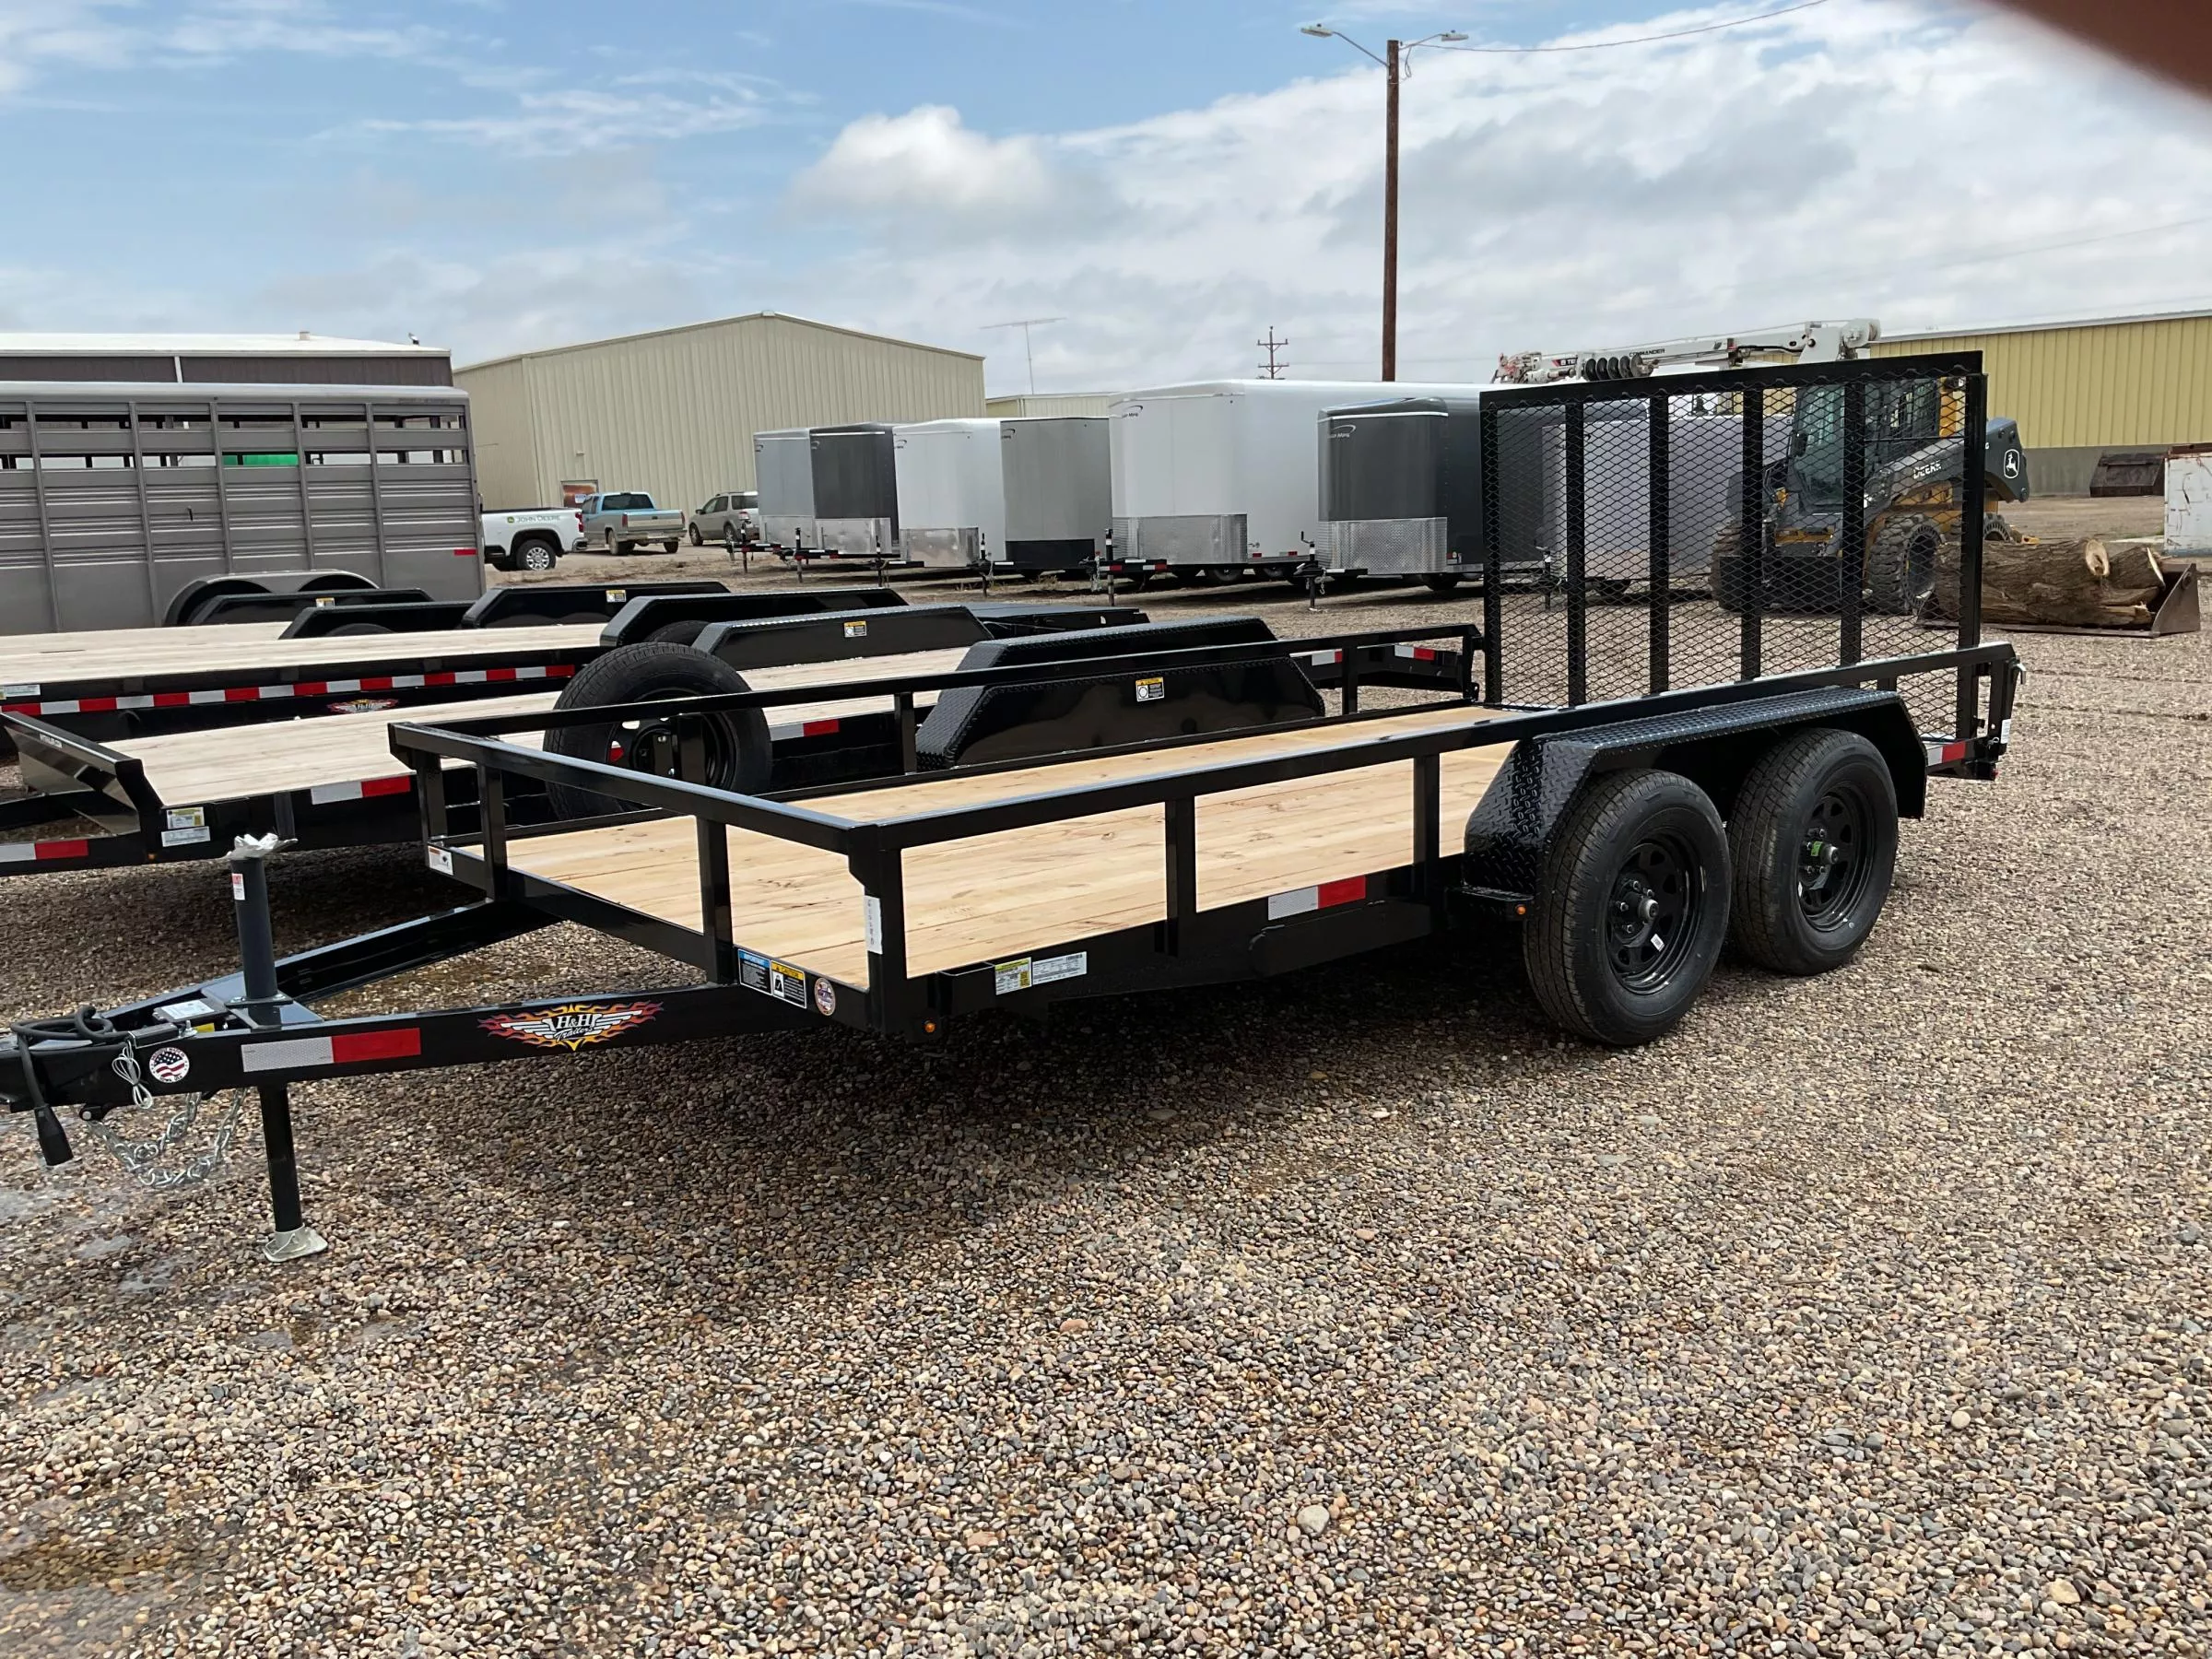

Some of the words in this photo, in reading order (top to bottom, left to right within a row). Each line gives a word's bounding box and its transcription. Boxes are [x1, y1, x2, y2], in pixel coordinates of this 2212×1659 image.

[1629, 348, 1665, 357] COMMANDER
[555, 1013, 594, 1030] H&H
[554, 1027, 593, 1042] Trailers
